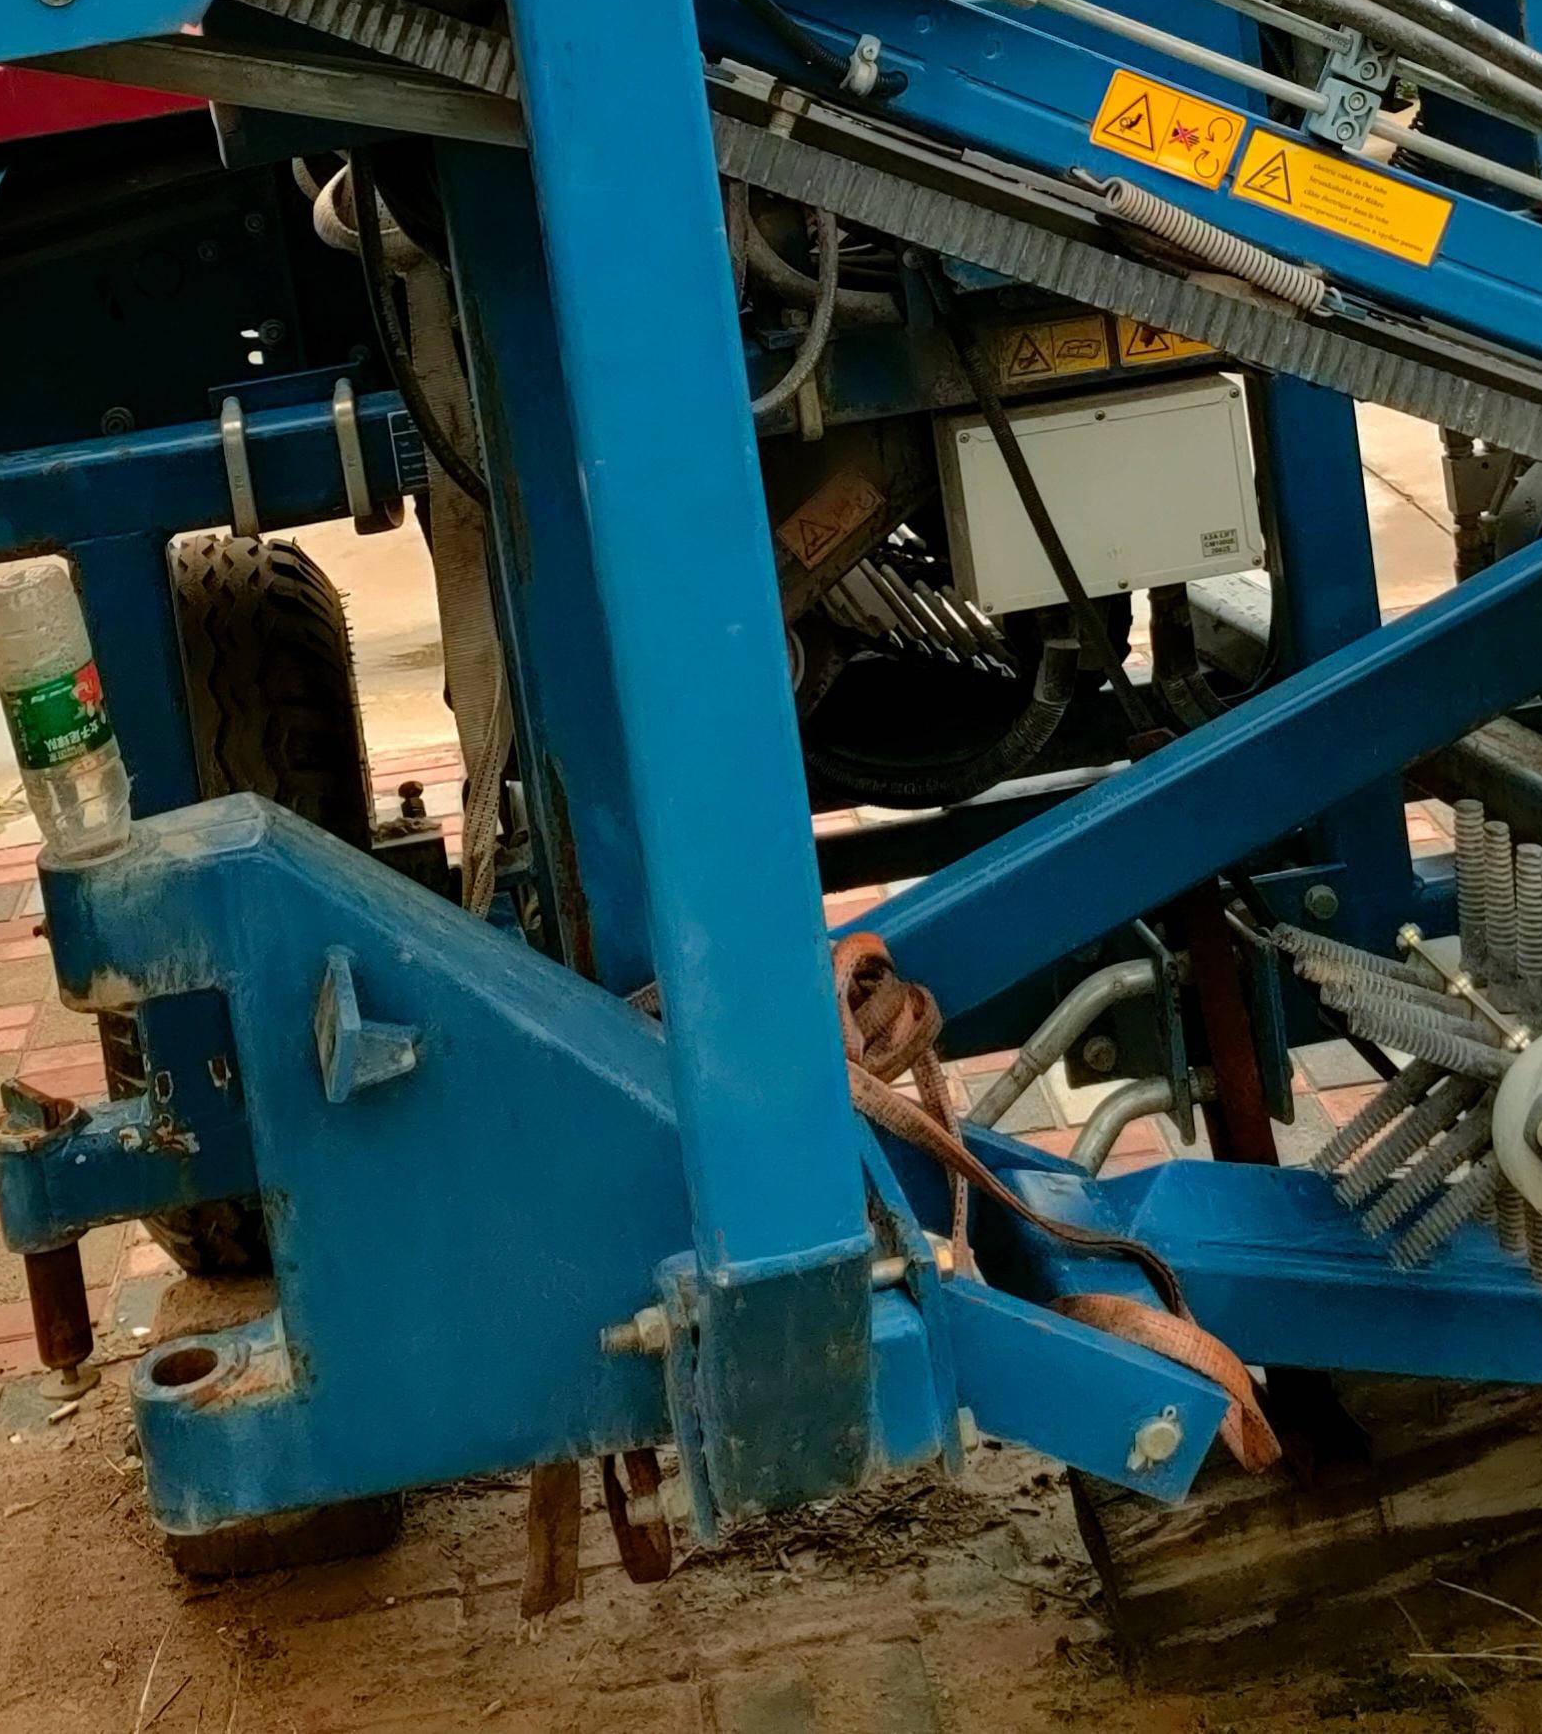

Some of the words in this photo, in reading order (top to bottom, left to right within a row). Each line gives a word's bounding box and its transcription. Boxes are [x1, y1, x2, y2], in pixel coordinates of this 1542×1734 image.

[43, 720, 99, 751] 女子足球队
